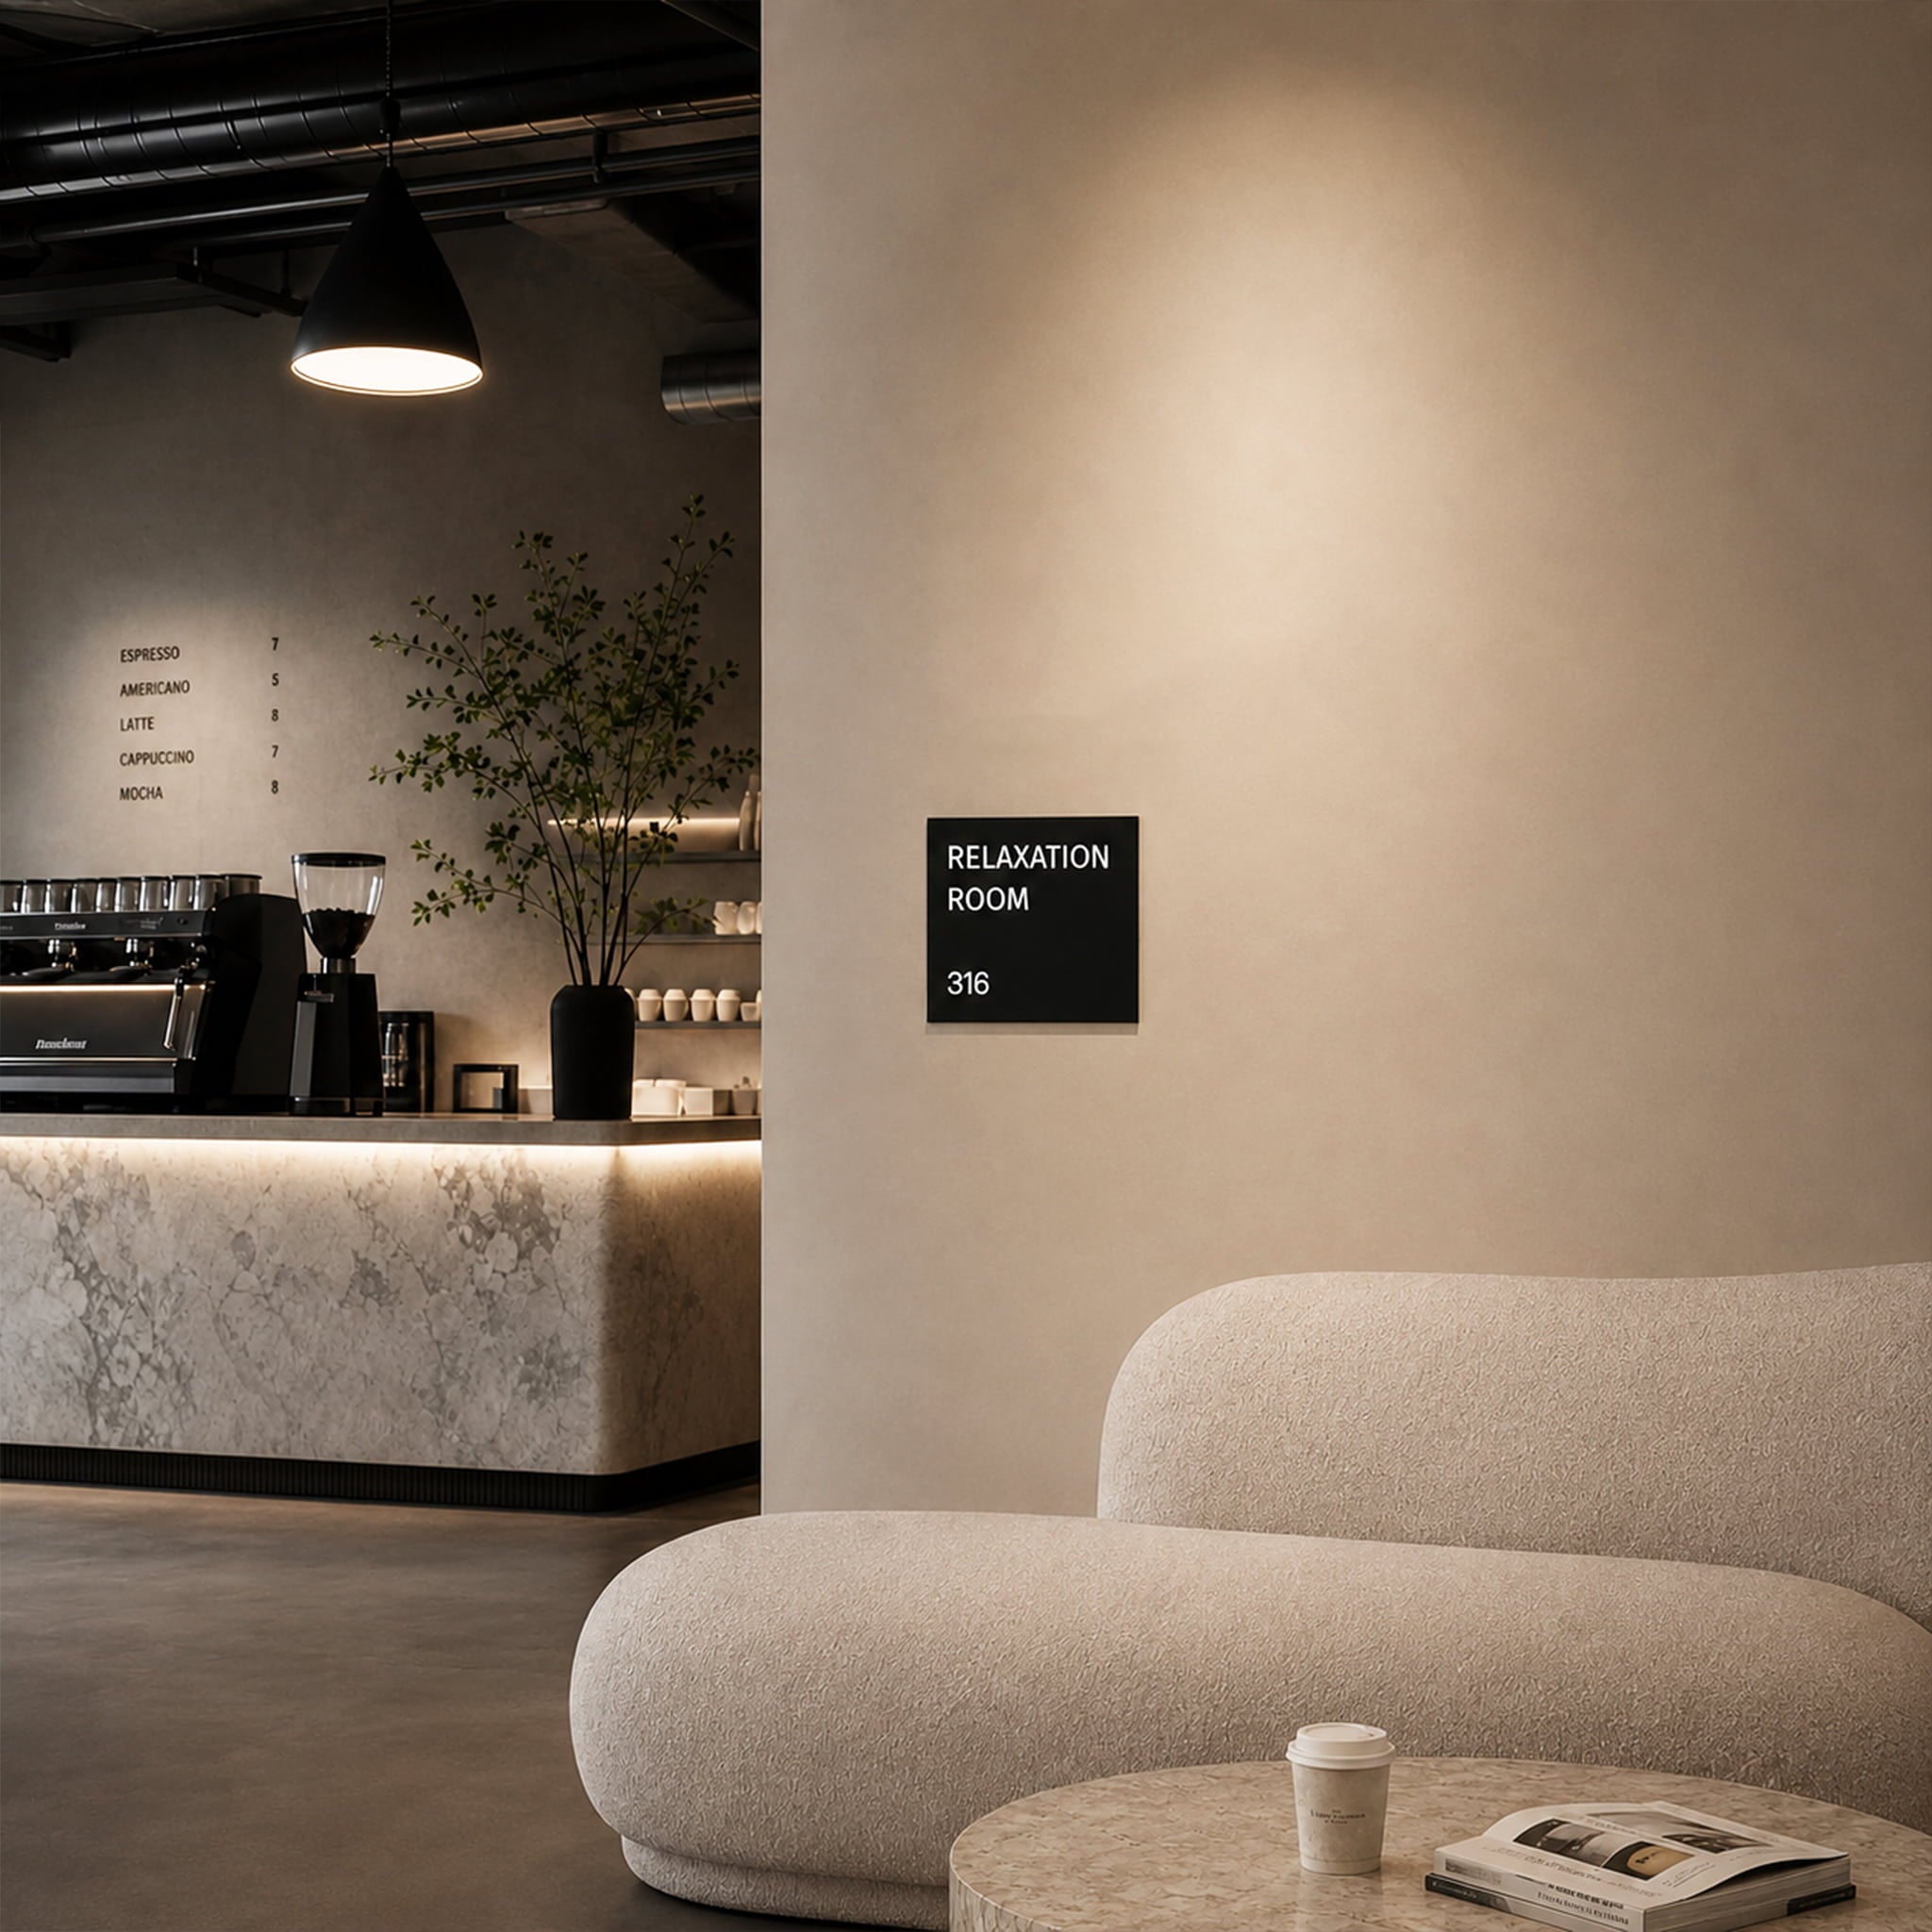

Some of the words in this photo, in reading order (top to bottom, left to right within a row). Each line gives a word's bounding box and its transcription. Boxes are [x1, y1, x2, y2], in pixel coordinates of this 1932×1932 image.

[120, 646, 180, 663] ESPRESSO
[271, 637, 279, 651] 7
[120, 680, 191, 697] AMERICANO
[272, 673, 279, 687] 5
[120, 716, 155, 732] LATTE
[271, 708, 279, 722] 8
[119, 750, 194, 767] CAPPUCCINO
[271, 744, 279, 758] 7
[119, 786, 163, 801] MOCHA
[271, 780, 279, 794] 8
[947, 844, 1109, 870] RELAXATION
[948, 887, 1029, 911] ROOM
[947, 971, 990, 995] 316
